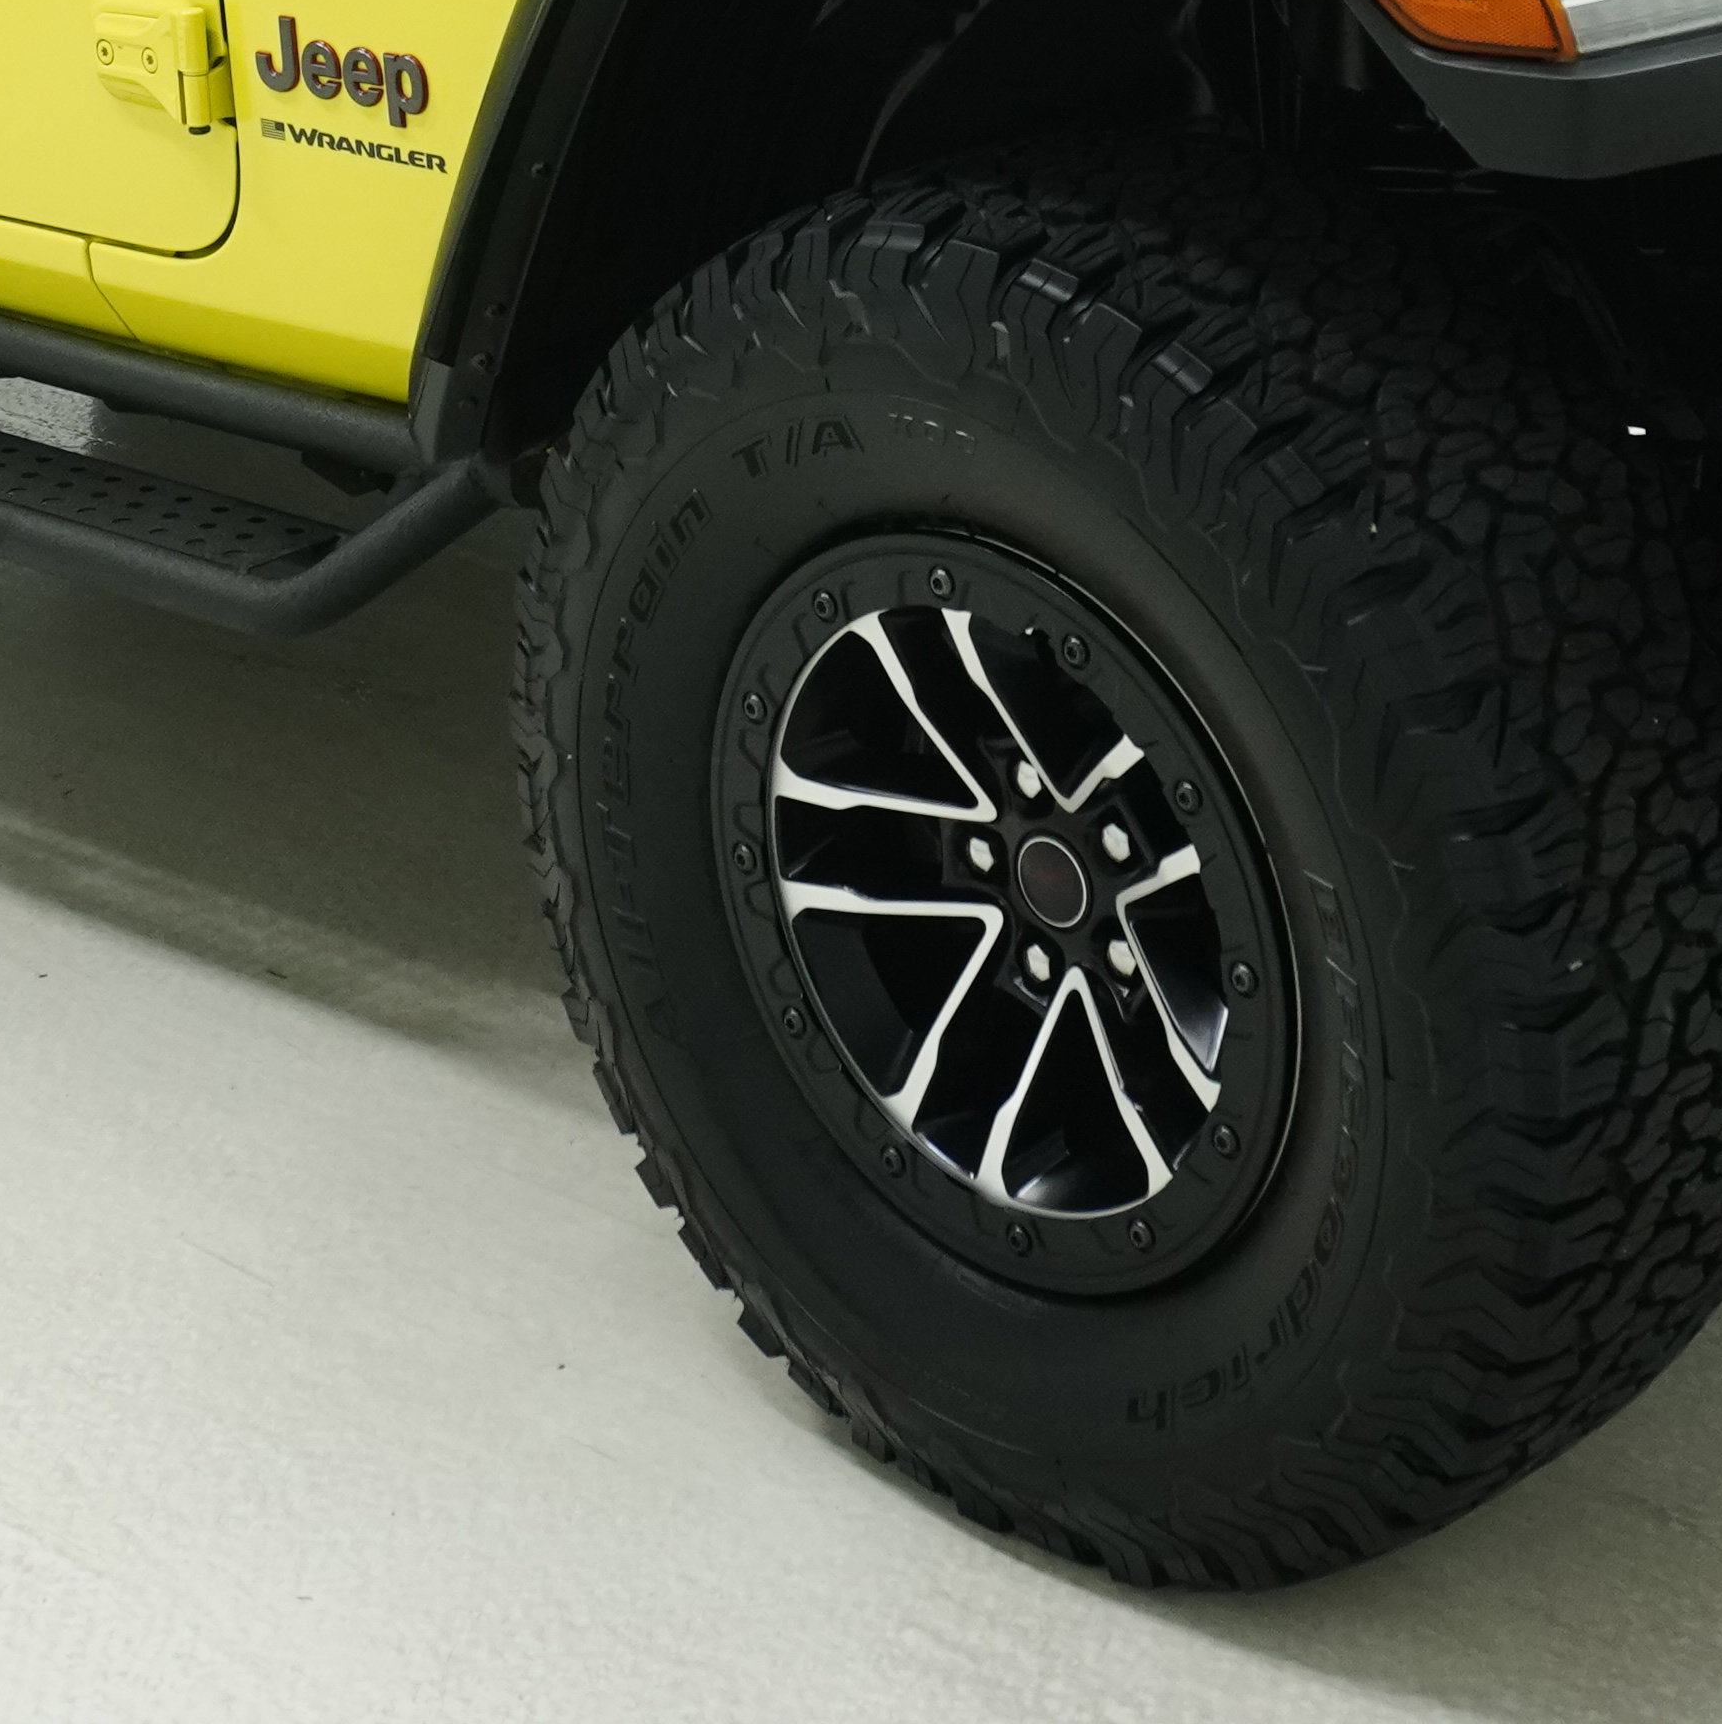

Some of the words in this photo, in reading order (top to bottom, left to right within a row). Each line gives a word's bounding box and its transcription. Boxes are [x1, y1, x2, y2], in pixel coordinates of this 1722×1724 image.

[254, 14, 429, 129] Jeep
[286, 123, 449, 175] WRANGLER
[731, 412, 865, 480] T/A
